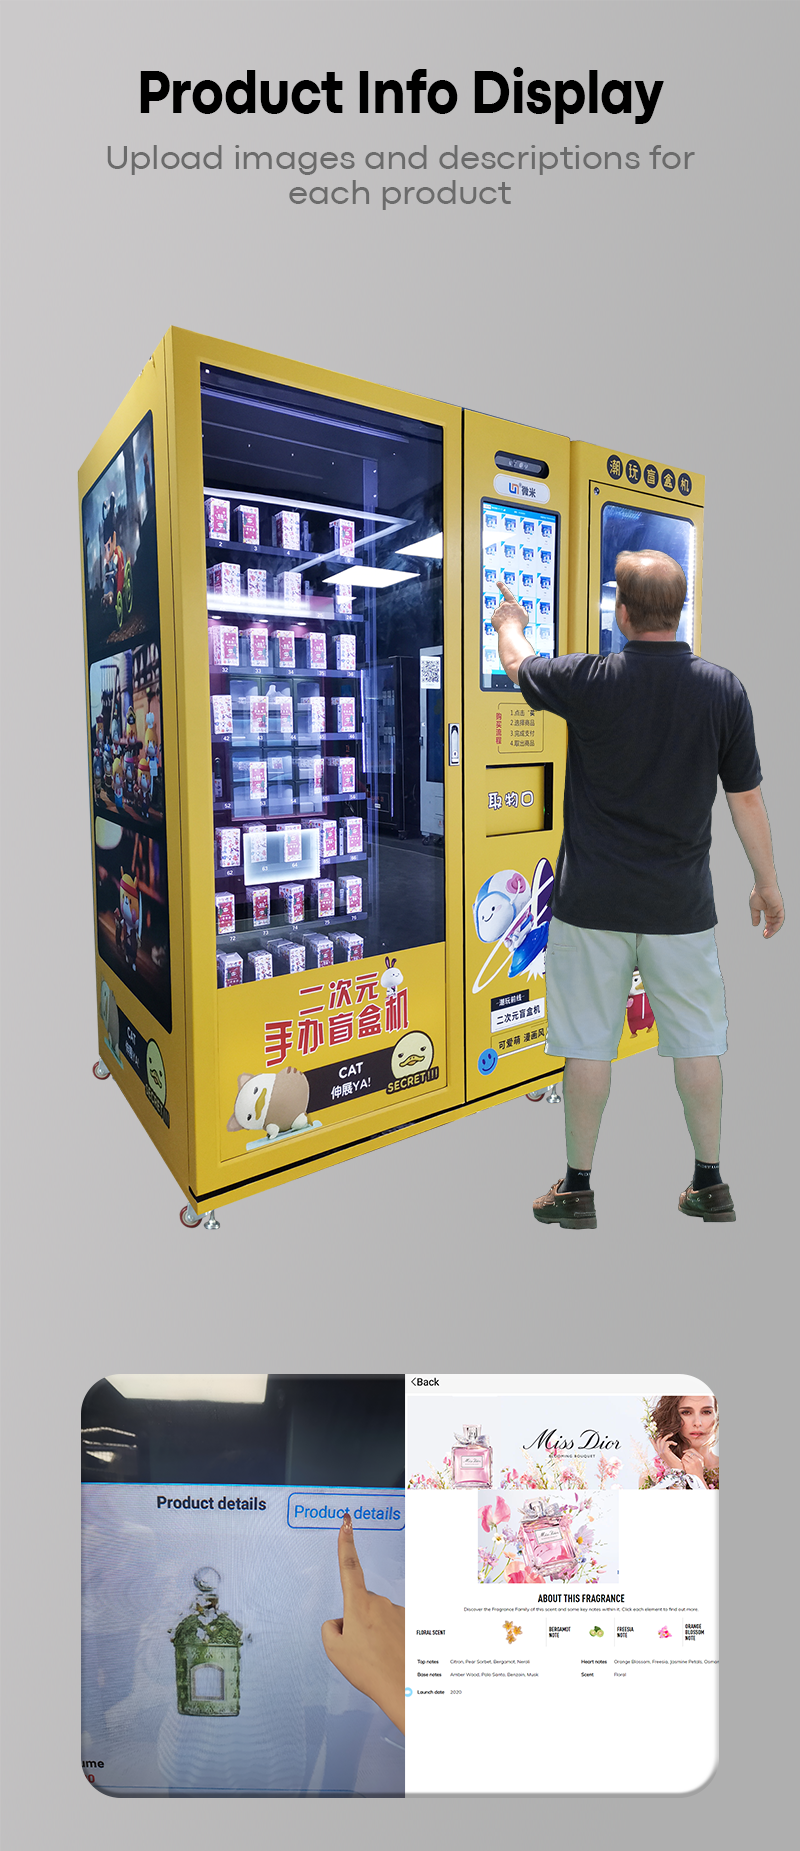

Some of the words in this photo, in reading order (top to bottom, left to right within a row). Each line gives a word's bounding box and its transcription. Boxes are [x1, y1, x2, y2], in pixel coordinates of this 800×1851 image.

[610, 459, 690, 493] 潮玩盲盒机
[488, 790, 534, 810] 取物口
[299, 972, 379, 1016] 二次元
[497, 1005, 540, 1025] 二次元盲盒机
[127, 1026, 136, 1045] CAT
[265, 987, 409, 1067] 手办盲盒机
[499, 1036, 520, 1049] 可爱萌
[524, 1028, 544, 1042] 漫画风
[339, 1062, 364, 1079] CAT
[331, 1077, 371, 1100] 伸展YA!
[417, 1378, 439, 1386] Back
[522, 1428, 575, 1450] Miss
[577, 1429, 622, 1450] Dior
[157, 1496, 214, 1510] Product
[218, 1497, 267, 1511] details
[295, 1505, 350, 1519] Product
[354, 1506, 401, 1521] details
[538, 1594, 562, 1603] ABOUT
[564, 1594, 580, 1602] THIS
[582, 1594, 625, 1603] FRAGRANCE
